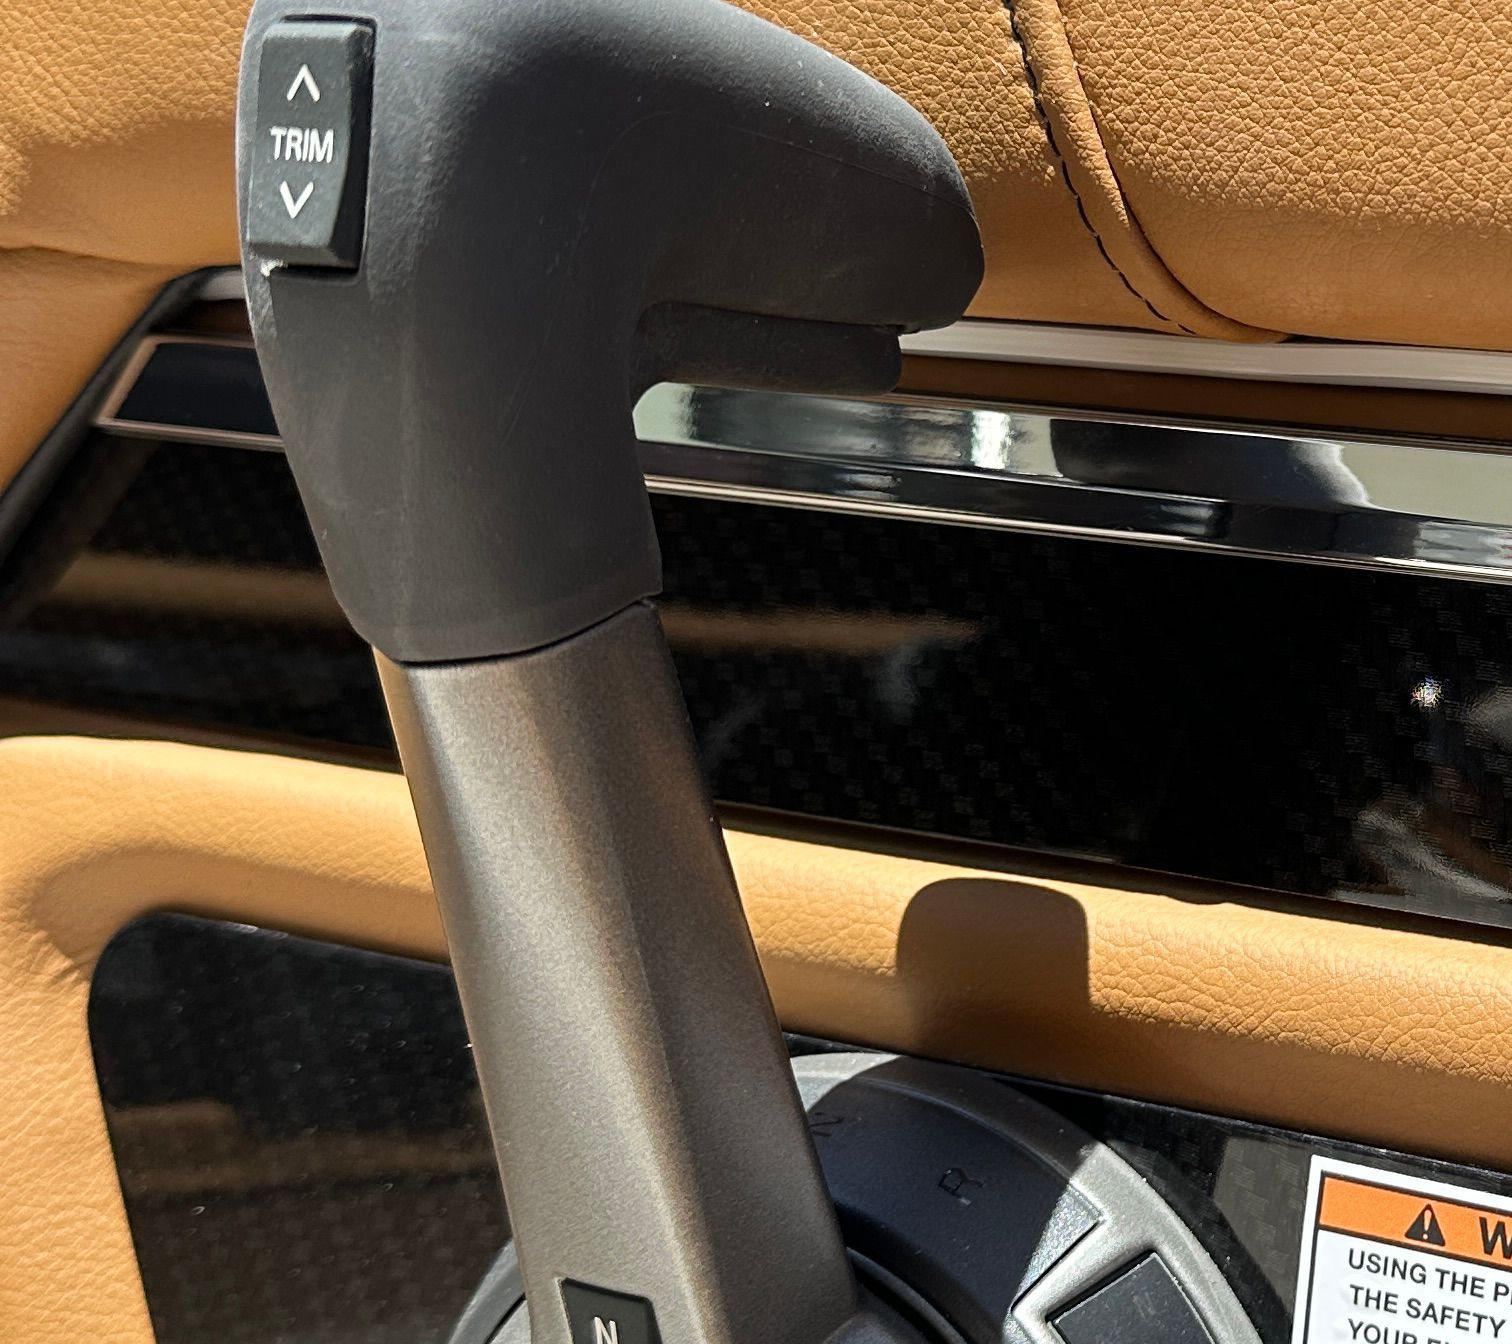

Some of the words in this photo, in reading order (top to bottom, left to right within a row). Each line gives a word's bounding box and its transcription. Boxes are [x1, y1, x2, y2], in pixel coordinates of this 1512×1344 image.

[270, 125, 334, 164] TRIM
[1349, 1248, 1427, 1286] USING
[1435, 1269, 1485, 1298] THE
[1350, 1285, 1398, 1313] THE
[1405, 1298, 1505, 1338] SAFETY
